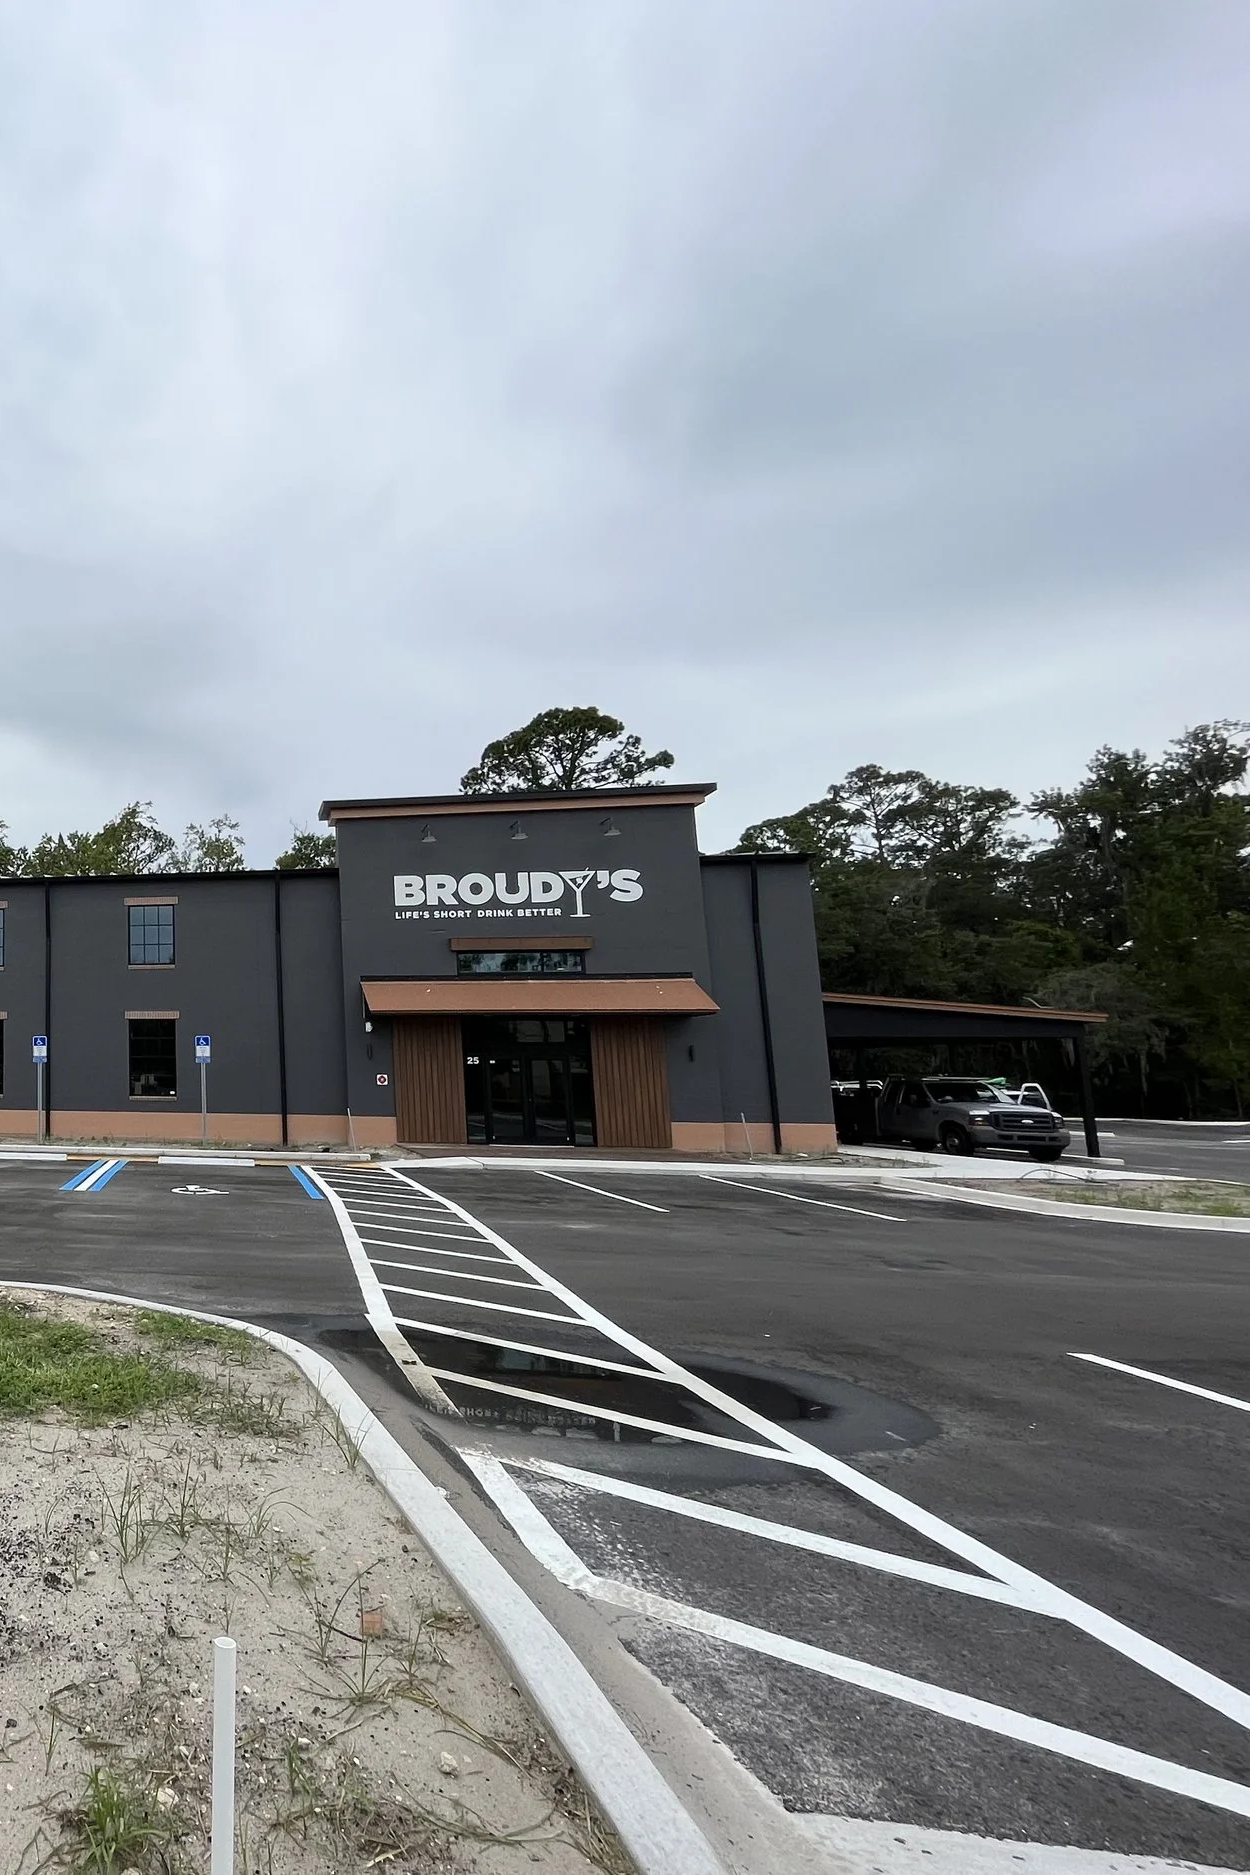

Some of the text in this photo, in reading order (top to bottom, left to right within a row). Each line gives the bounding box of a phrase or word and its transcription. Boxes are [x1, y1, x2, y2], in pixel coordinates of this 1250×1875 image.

[394, 867, 644, 917] BROUDY'S
[395, 908, 562, 920] LIFE'S SHORT DRINK BETTER
[467, 1057, 479, 1065] 25
